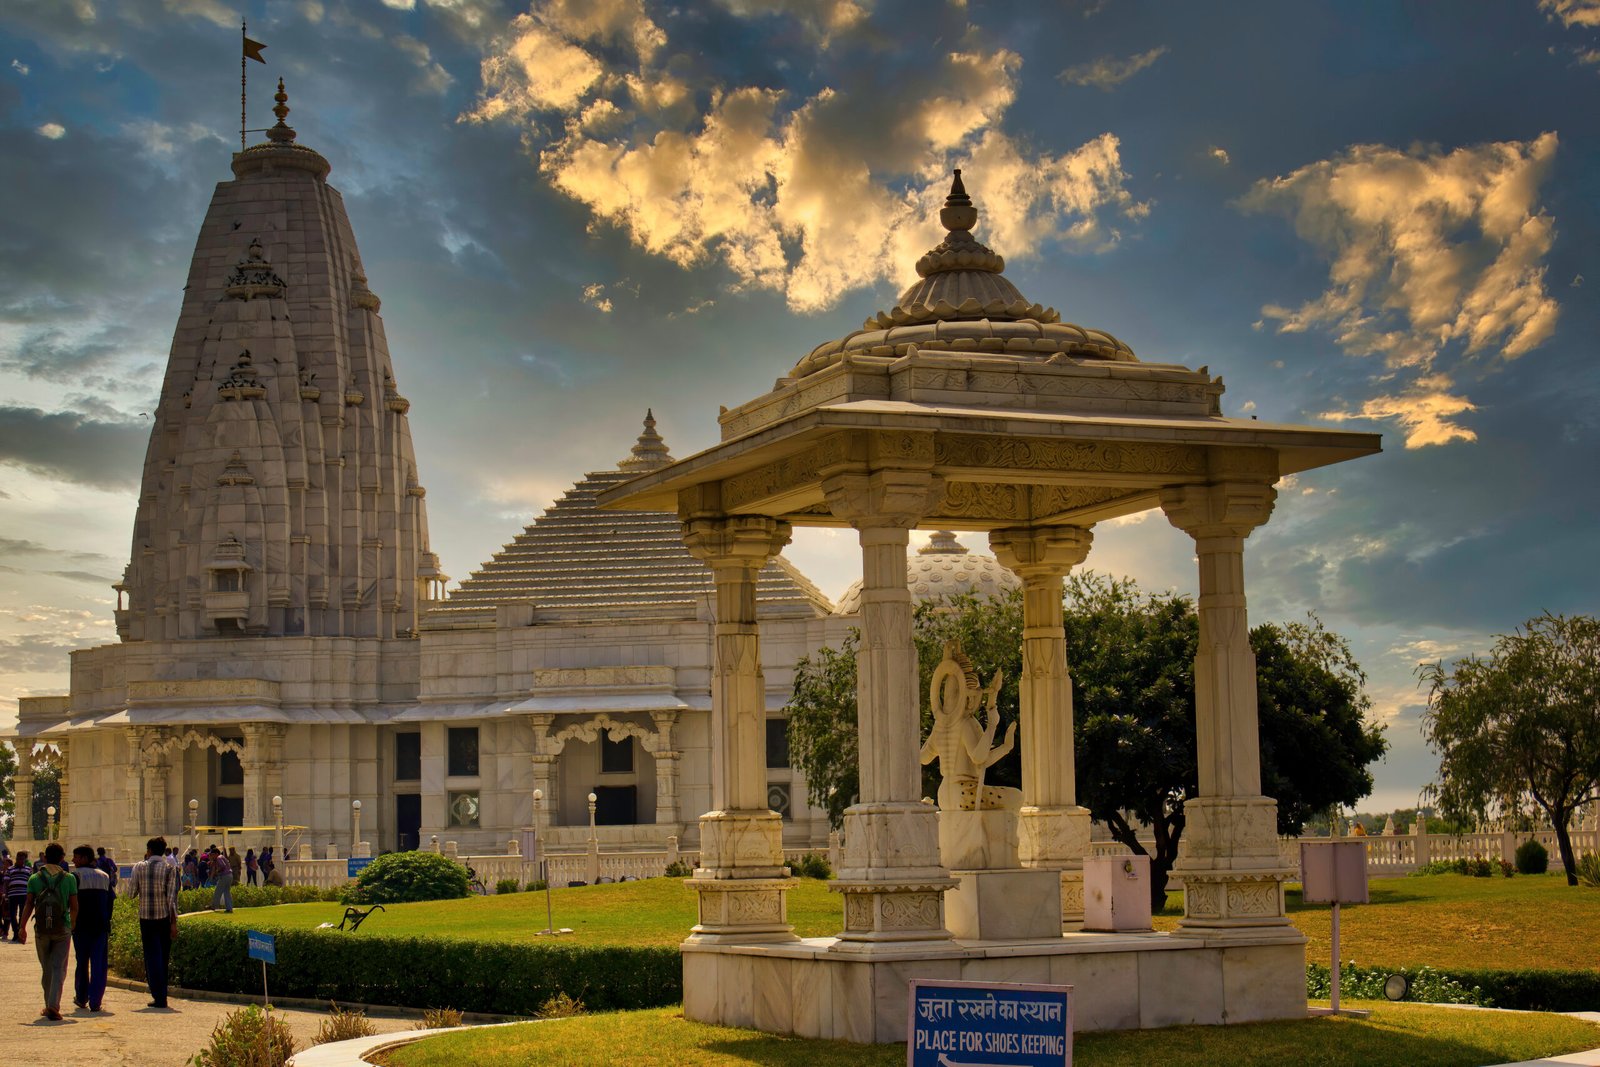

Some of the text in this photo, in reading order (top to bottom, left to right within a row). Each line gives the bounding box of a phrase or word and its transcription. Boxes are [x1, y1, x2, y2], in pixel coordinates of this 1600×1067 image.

[918, 993, 1063, 1023] जूता रखने का स्थान
[916, 1029, 1064, 1056] PLACE FOR SHOES KEEPING
